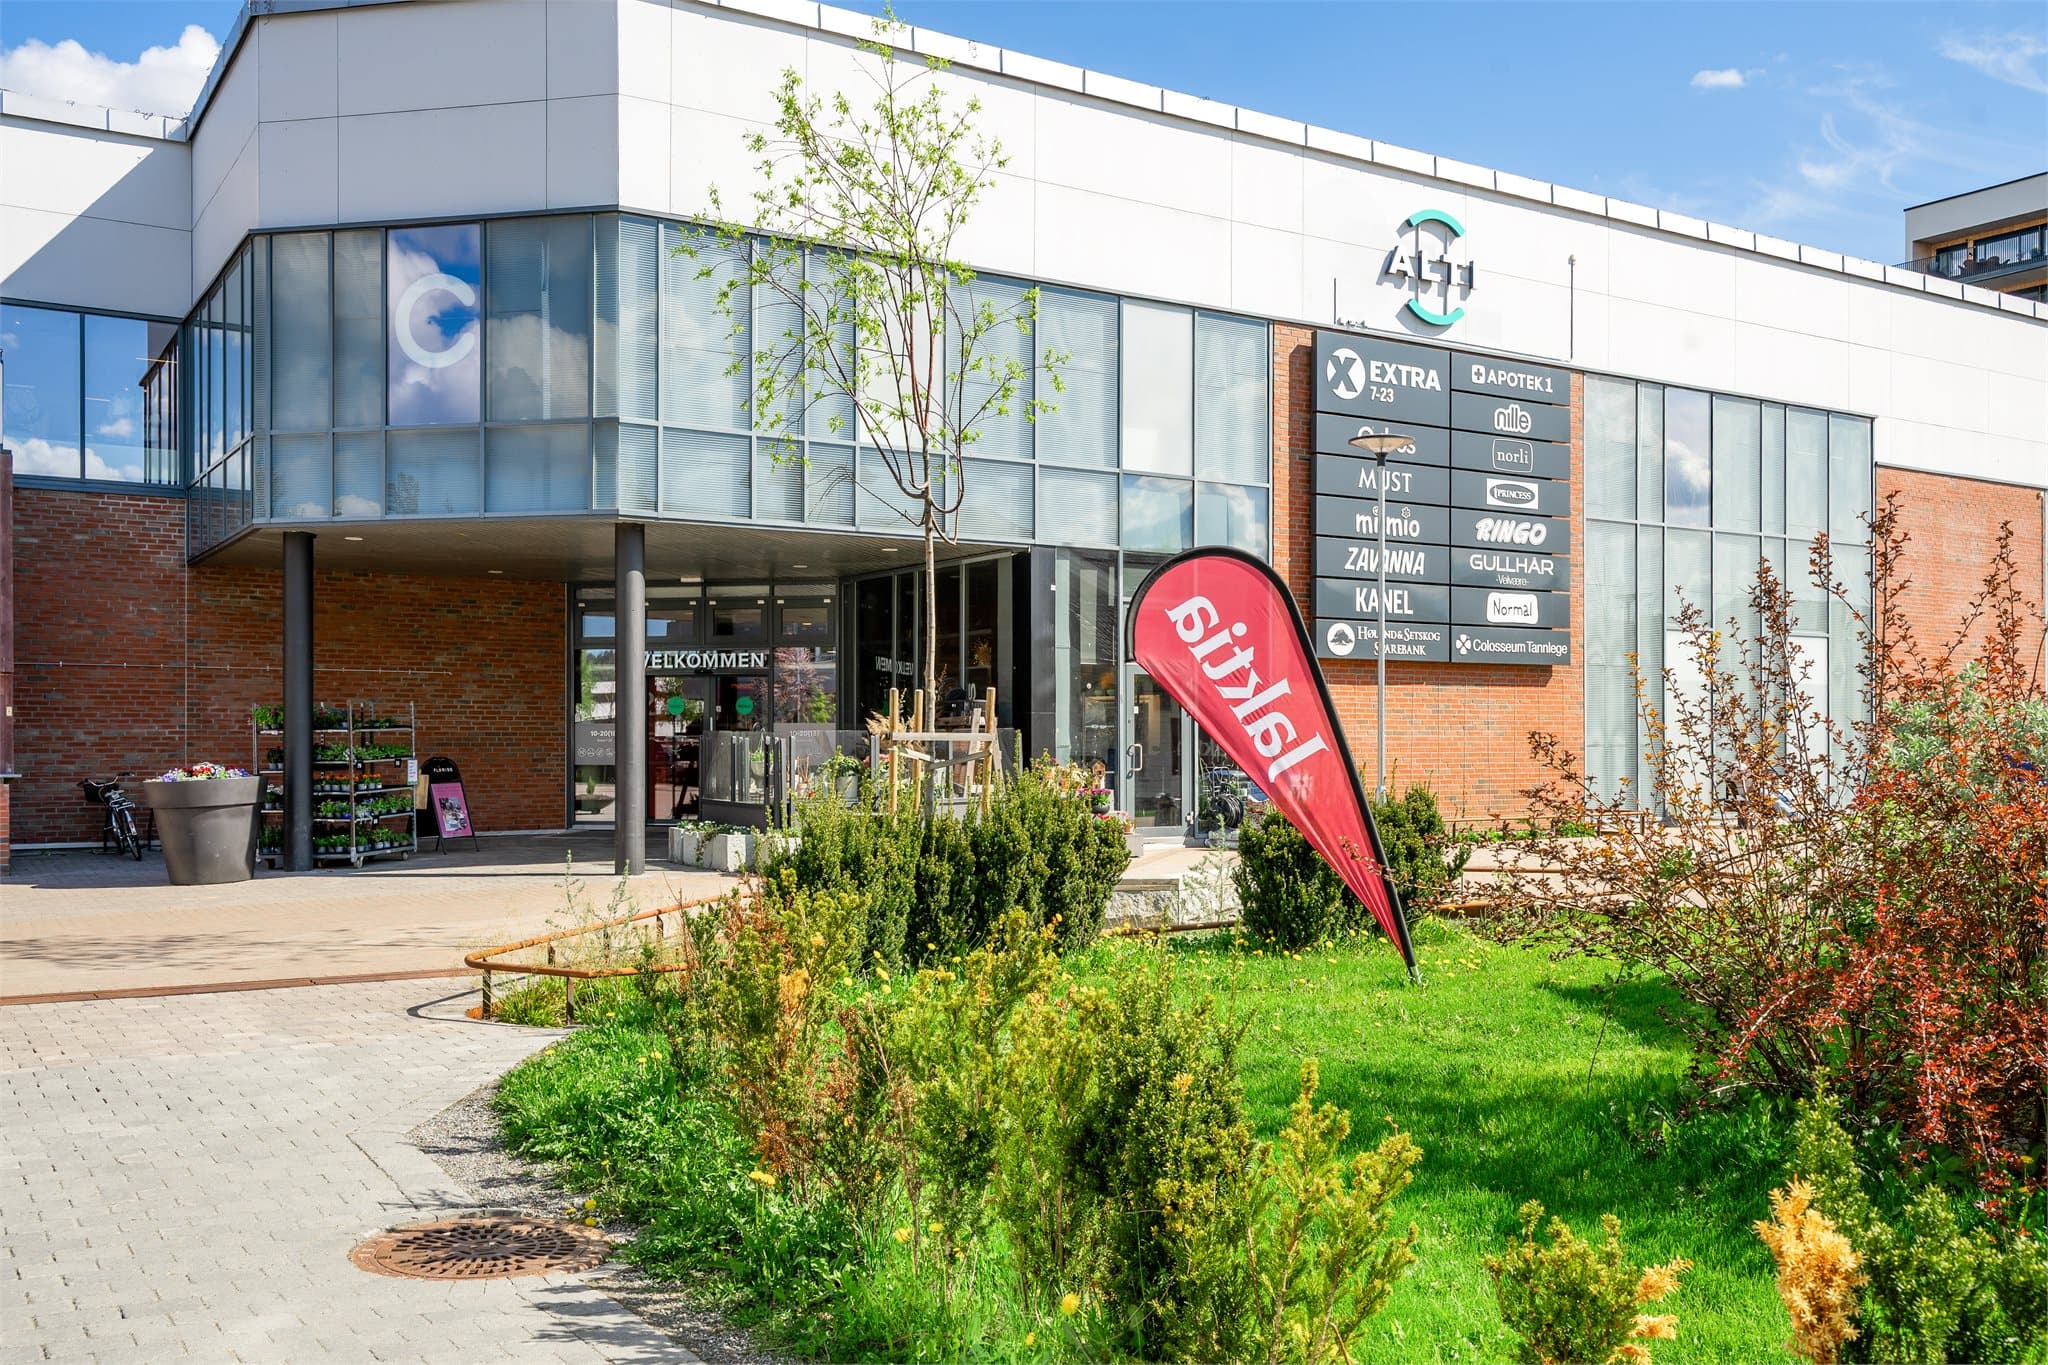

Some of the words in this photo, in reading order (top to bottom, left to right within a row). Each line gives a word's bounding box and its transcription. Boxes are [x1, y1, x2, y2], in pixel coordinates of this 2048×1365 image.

[1384, 244, 1478, 290] ALTI
[1369, 360, 1441, 391] EXTRA
[1487, 369, 1544, 391] APOTEK
[1545, 378, 1553, 393] 1
[1370, 386, 1394, 402] 7-23
[1494, 404, 1531, 433] nille
[1496, 448, 1529, 464] norli
[1358, 466, 1412, 493] MUST
[1476, 518, 1547, 545] RINGO
[1355, 587, 1414, 615] KANEL
[1493, 598, 1533, 617] Normal
[1357, 626, 1398, 640] HØLND
[1374, 642, 1426, 656] SAREBANK
[1473, 639, 1526, 654] Colosseum
[1526, 641, 1568, 657] Tannlege
